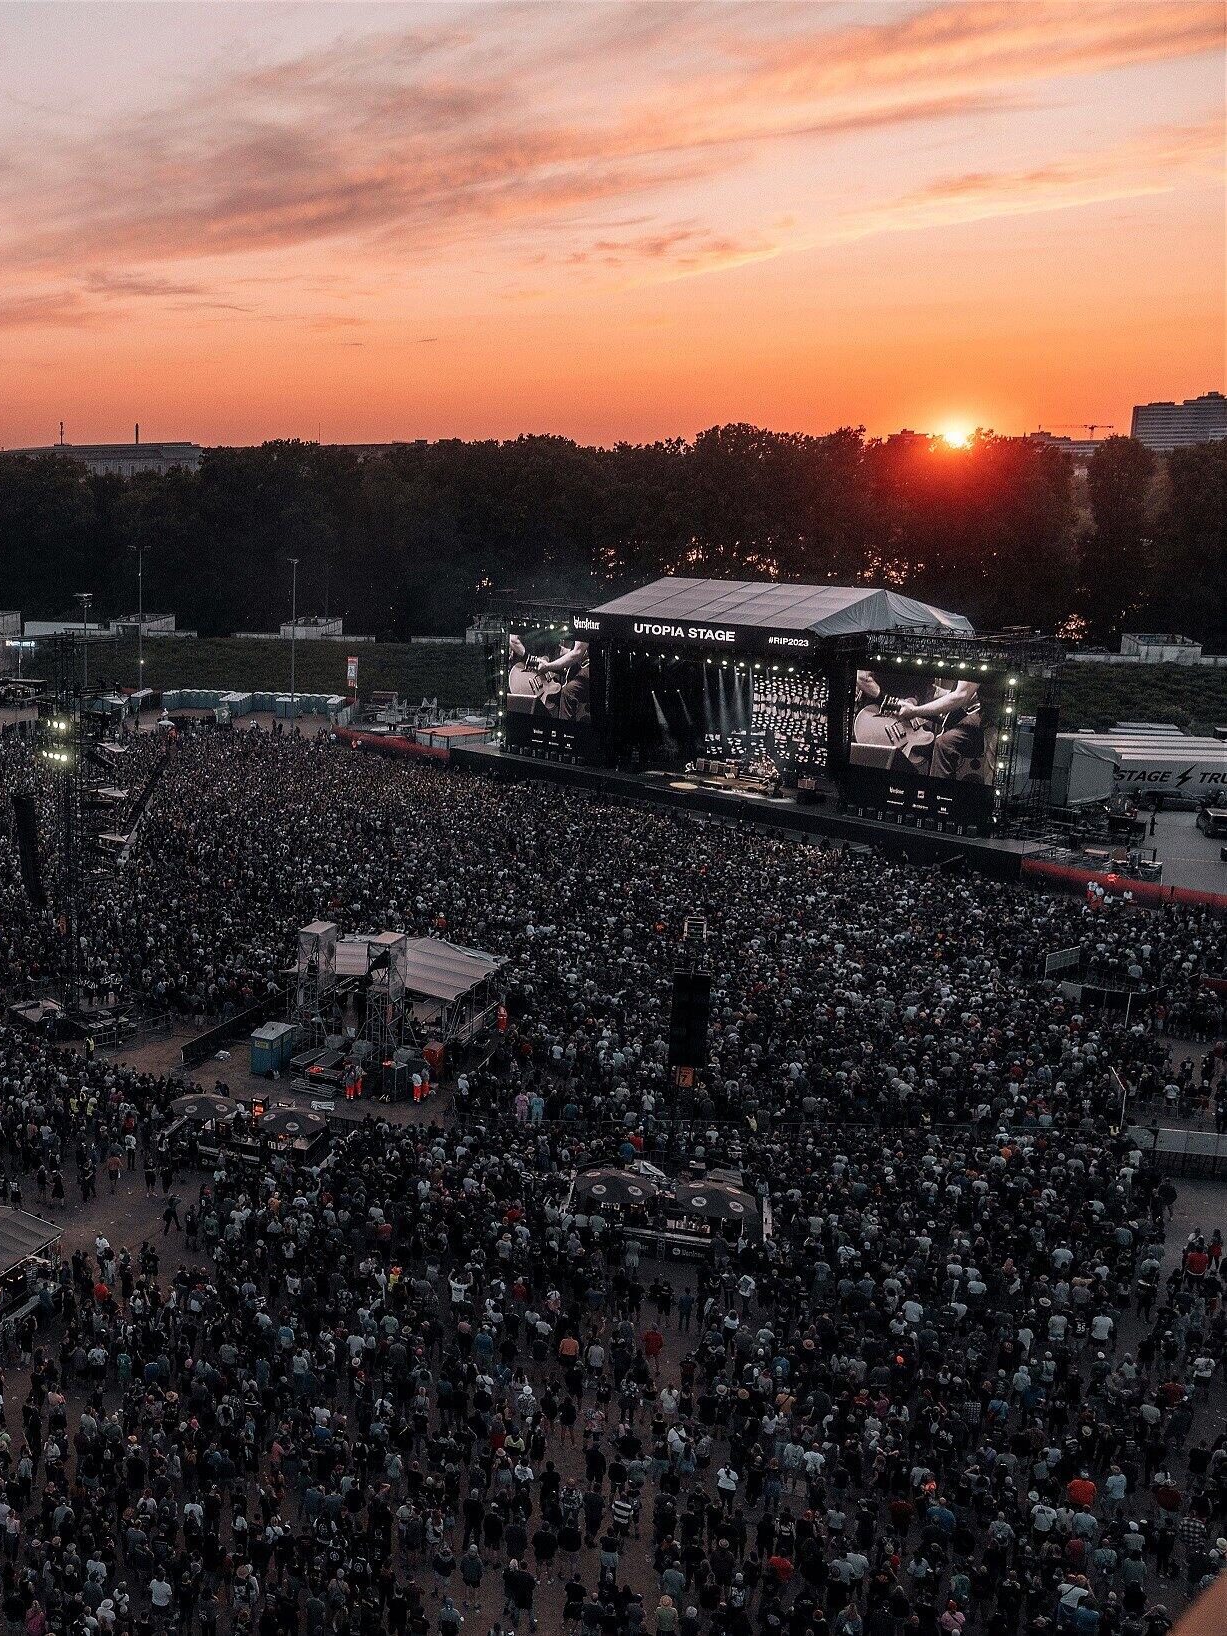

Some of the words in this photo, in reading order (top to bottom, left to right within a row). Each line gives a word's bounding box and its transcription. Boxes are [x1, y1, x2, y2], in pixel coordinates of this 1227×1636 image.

[634, 622, 684, 638] UTOPIA
[688, 627, 736, 642] STAGE
[768, 636, 809, 647] #RIP2023
[1113, 770, 1172, 783] STAGE
